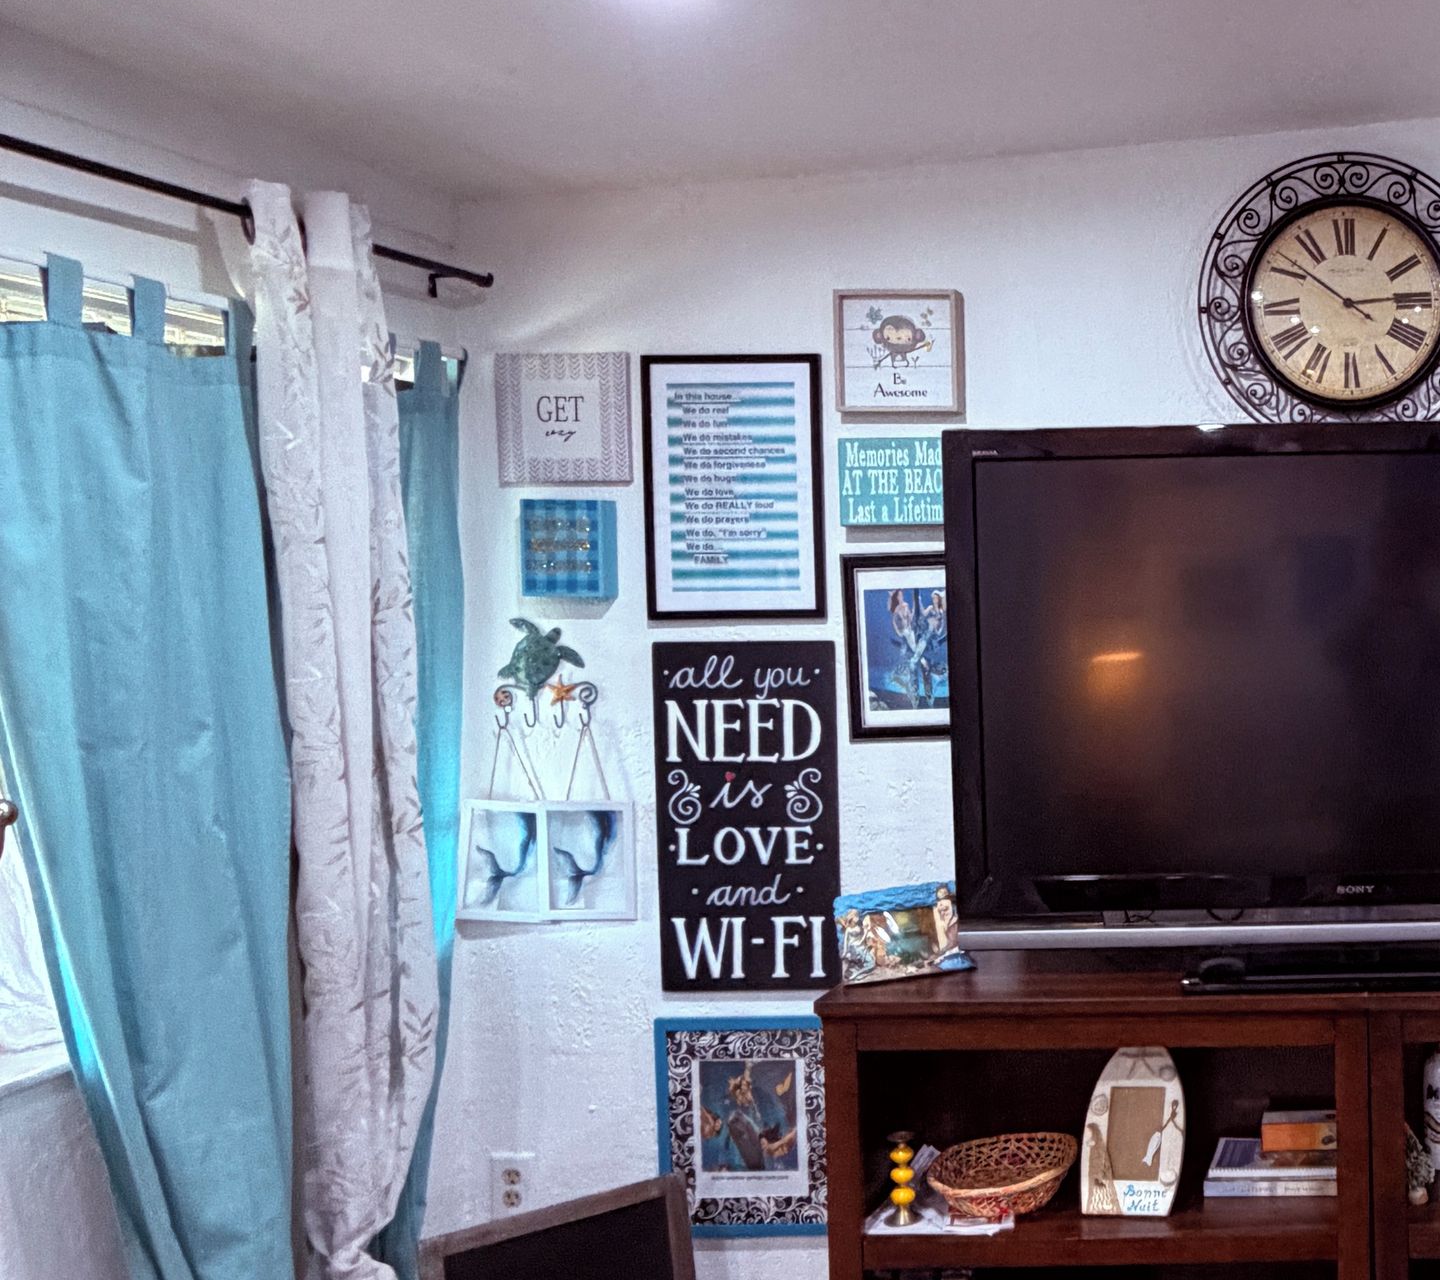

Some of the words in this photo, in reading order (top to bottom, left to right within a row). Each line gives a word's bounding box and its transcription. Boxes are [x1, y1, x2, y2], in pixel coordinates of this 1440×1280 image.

[893, 373, 907, 385] Be
[873, 383, 928, 398] Awesome
[537, 395, 584, 422] GET
[682, 406, 697, 415] We
[698, 406, 710, 414] do
[683, 420, 697, 428] We
[698, 420, 711, 428] do
[683, 434, 697, 442] We
[713, 434, 753, 442] mistakes
[683, 448, 698, 456] We
[700, 447, 711, 455] do
[713, 447, 747, 455] second
[748, 447, 785, 455] chances
[845, 441, 910, 467] Memories
[914, 440, 942, 467] Mad
[684, 461, 698, 469] We
[700, 461, 712, 469] do
[713, 461, 766, 471] forgiveness
[684, 475, 698, 483] We
[842, 469, 863, 496] AT
[868, 469, 899, 495] THE
[904, 469, 943, 494] BEAC
[685, 488, 699, 496] We
[701, 488, 713, 496] do
[715, 488, 735, 496] love
[685, 502, 699, 510] We
[702, 502, 714, 510] do
[716, 502, 752, 510] REALLY
[755, 501, 774, 509] loud
[848, 497, 876, 523] Last
[881, 504, 888, 522] a
[894, 496, 943, 522] Lifetim
[686, 516, 700, 524] We
[702, 515, 714, 524] do
[715, 516, 750, 525] prayers
[686, 529, 700, 537] We
[686, 543, 700, 551] We
[694, 555, 729, 564] FAMILY
[669, 655, 743, 689] all
[754, 667, 811, 700] you
[664, 698, 822, 763] NEED
[709, 771, 773, 808] is
[675, 826, 815, 866] LOVE
[706, 873, 791, 906] and
[1336, 885, 1375, 895] SONY
[670, 915, 827, 980] WI-FI
[1123, 1184, 1167, 1199] Bonne
[1126, 1199, 1159, 1212] Nuit
